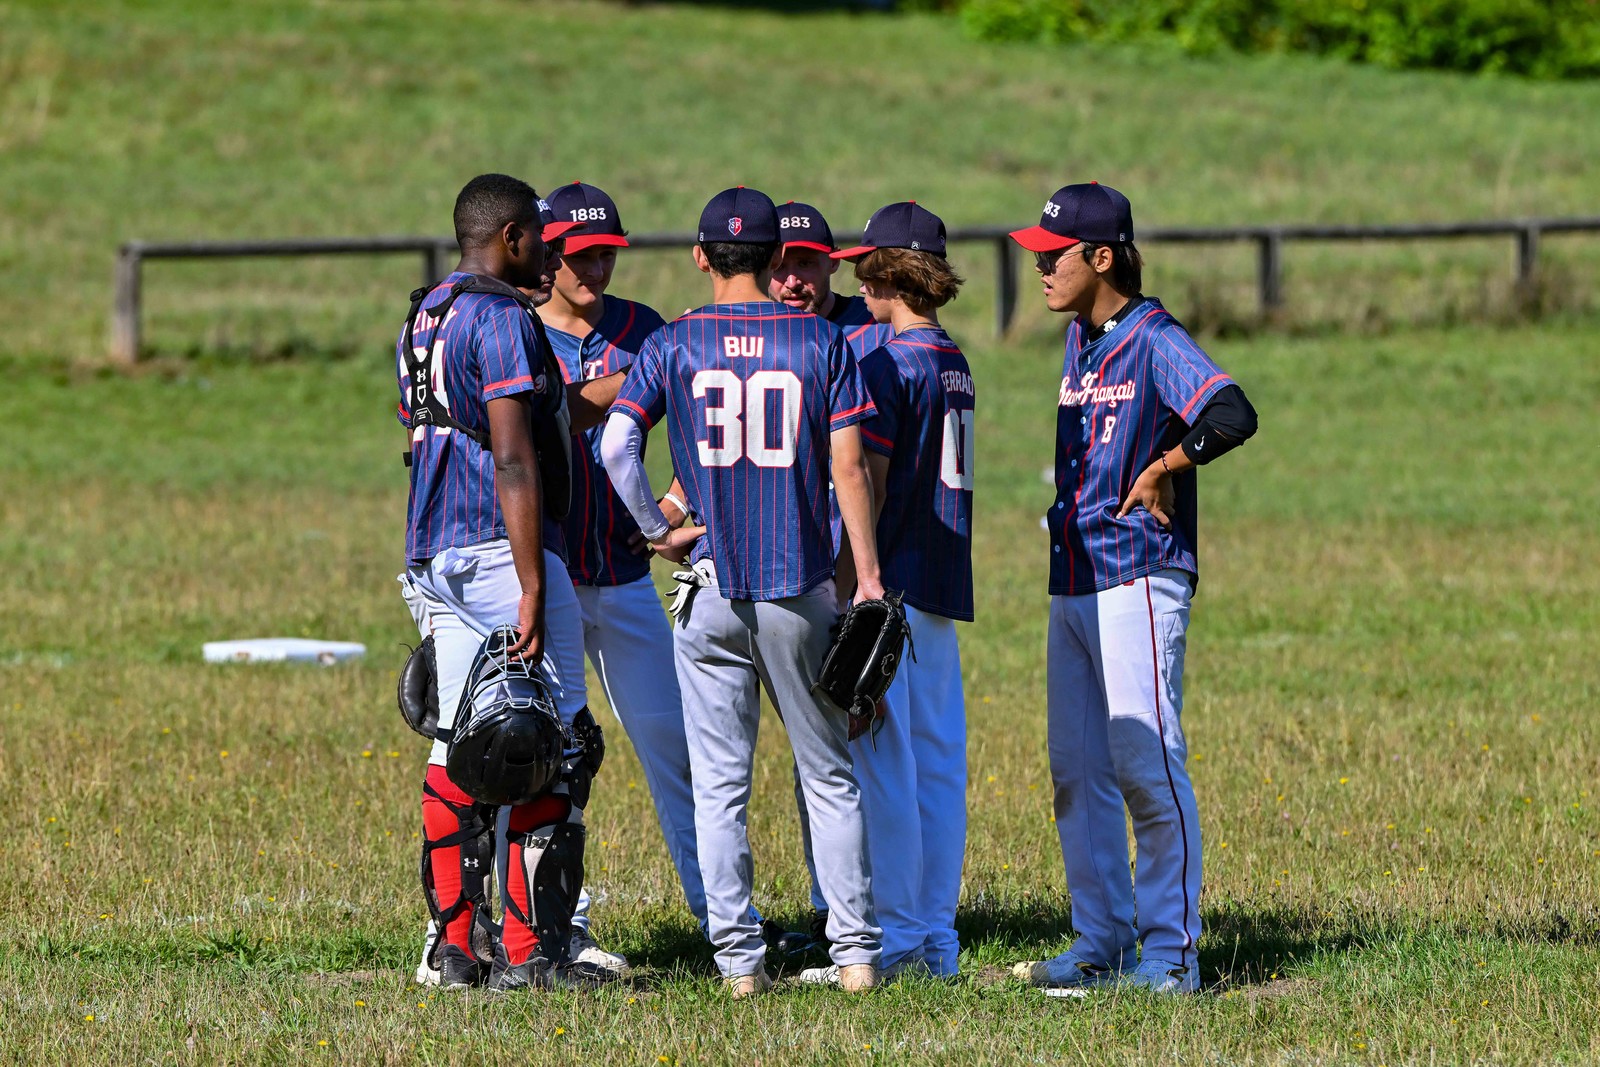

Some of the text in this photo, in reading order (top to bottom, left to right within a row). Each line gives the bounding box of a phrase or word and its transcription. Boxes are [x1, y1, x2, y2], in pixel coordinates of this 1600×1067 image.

[570, 207, 607, 222] 1883
[723, 336, 764, 358] BUI
[1081, 371, 1136, 408] Français
[691, 369, 802, 468] 30
[1101, 414, 1117, 444] 8
